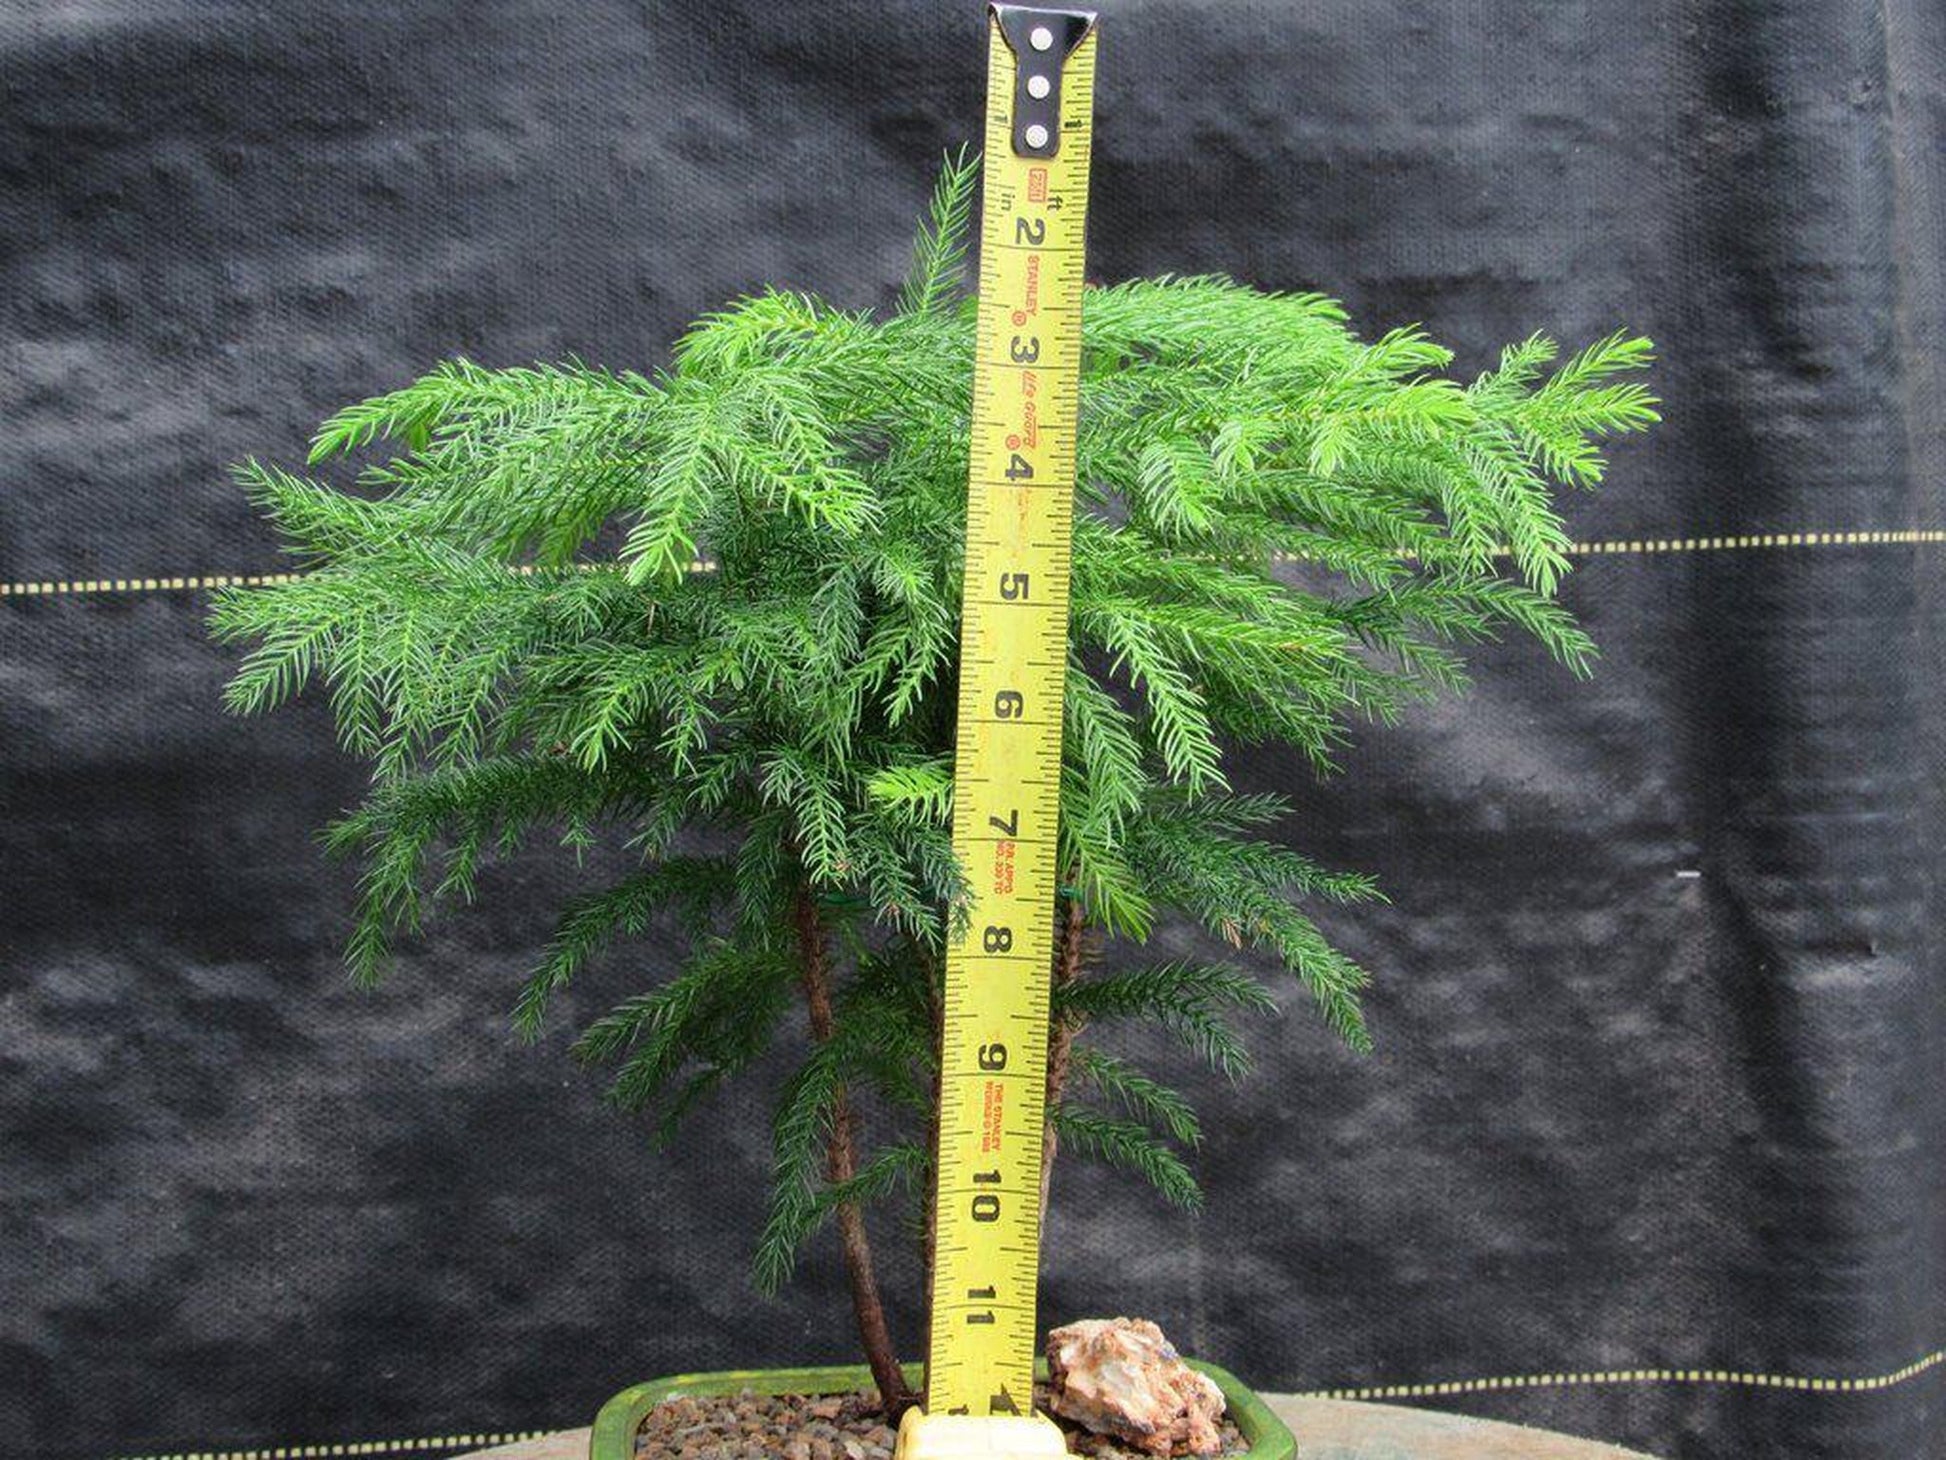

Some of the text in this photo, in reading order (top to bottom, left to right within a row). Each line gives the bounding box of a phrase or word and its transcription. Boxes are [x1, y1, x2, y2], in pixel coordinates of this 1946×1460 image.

[1065, 119, 1083, 129] 1
[1001, 193, 1017, 211] in
[1047, 195, 1063, 211] ft
[1015, 217, 1046, 246] 2
[1025, 254, 1041, 318] STANLEY
[1010, 335, 1040, 365] 3
[1004, 454, 1035, 482] 4
[1000, 572, 1029, 601] 5
[994, 690, 1024, 719] 6
[989, 809, 1019, 837] 7
[983, 925, 1013, 954] 8
[978, 1043, 1008, 1072] 9
[971, 1169, 1002, 1223] 10
[966, 1285, 997, 1325] 11
